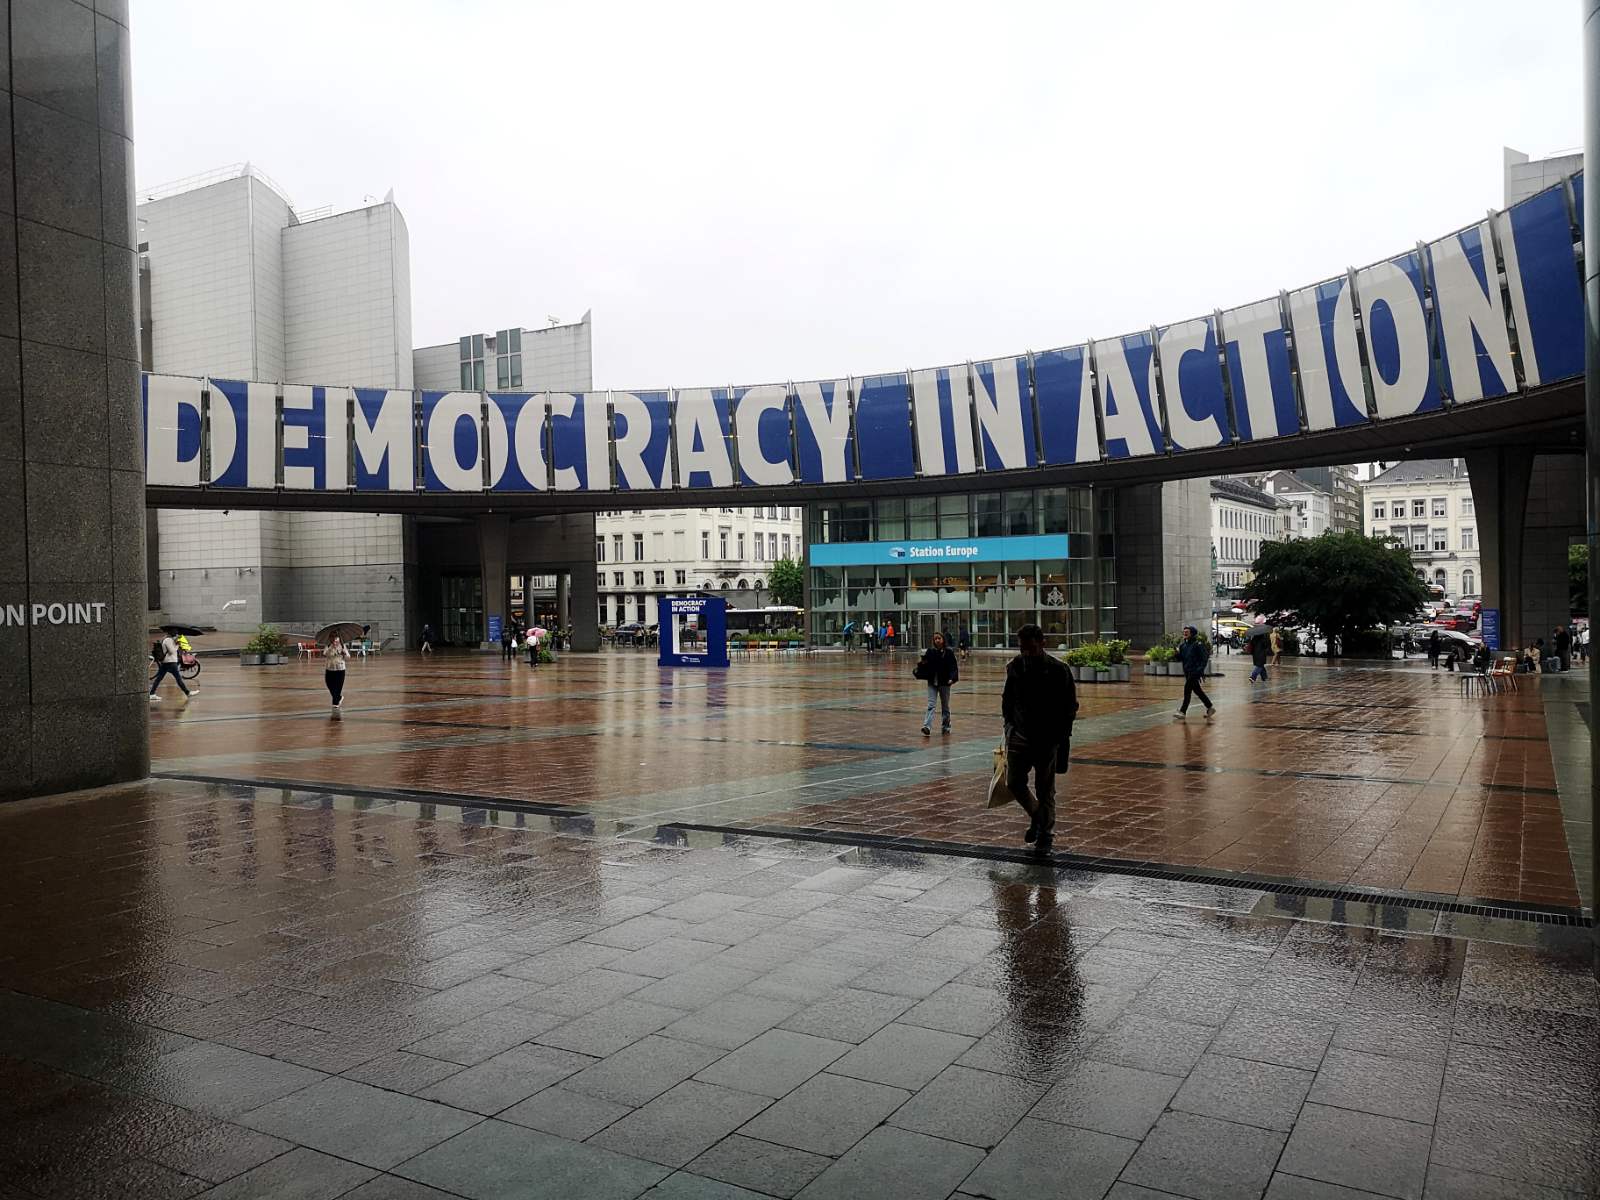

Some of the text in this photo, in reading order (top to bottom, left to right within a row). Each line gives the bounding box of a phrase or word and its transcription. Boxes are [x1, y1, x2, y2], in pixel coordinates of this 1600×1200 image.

[146, 210, 1541, 492] DEMOCRACY IN ACTION
[910, 545, 978, 558] Station Europe
[0, 603, 105, 626] N POINT
